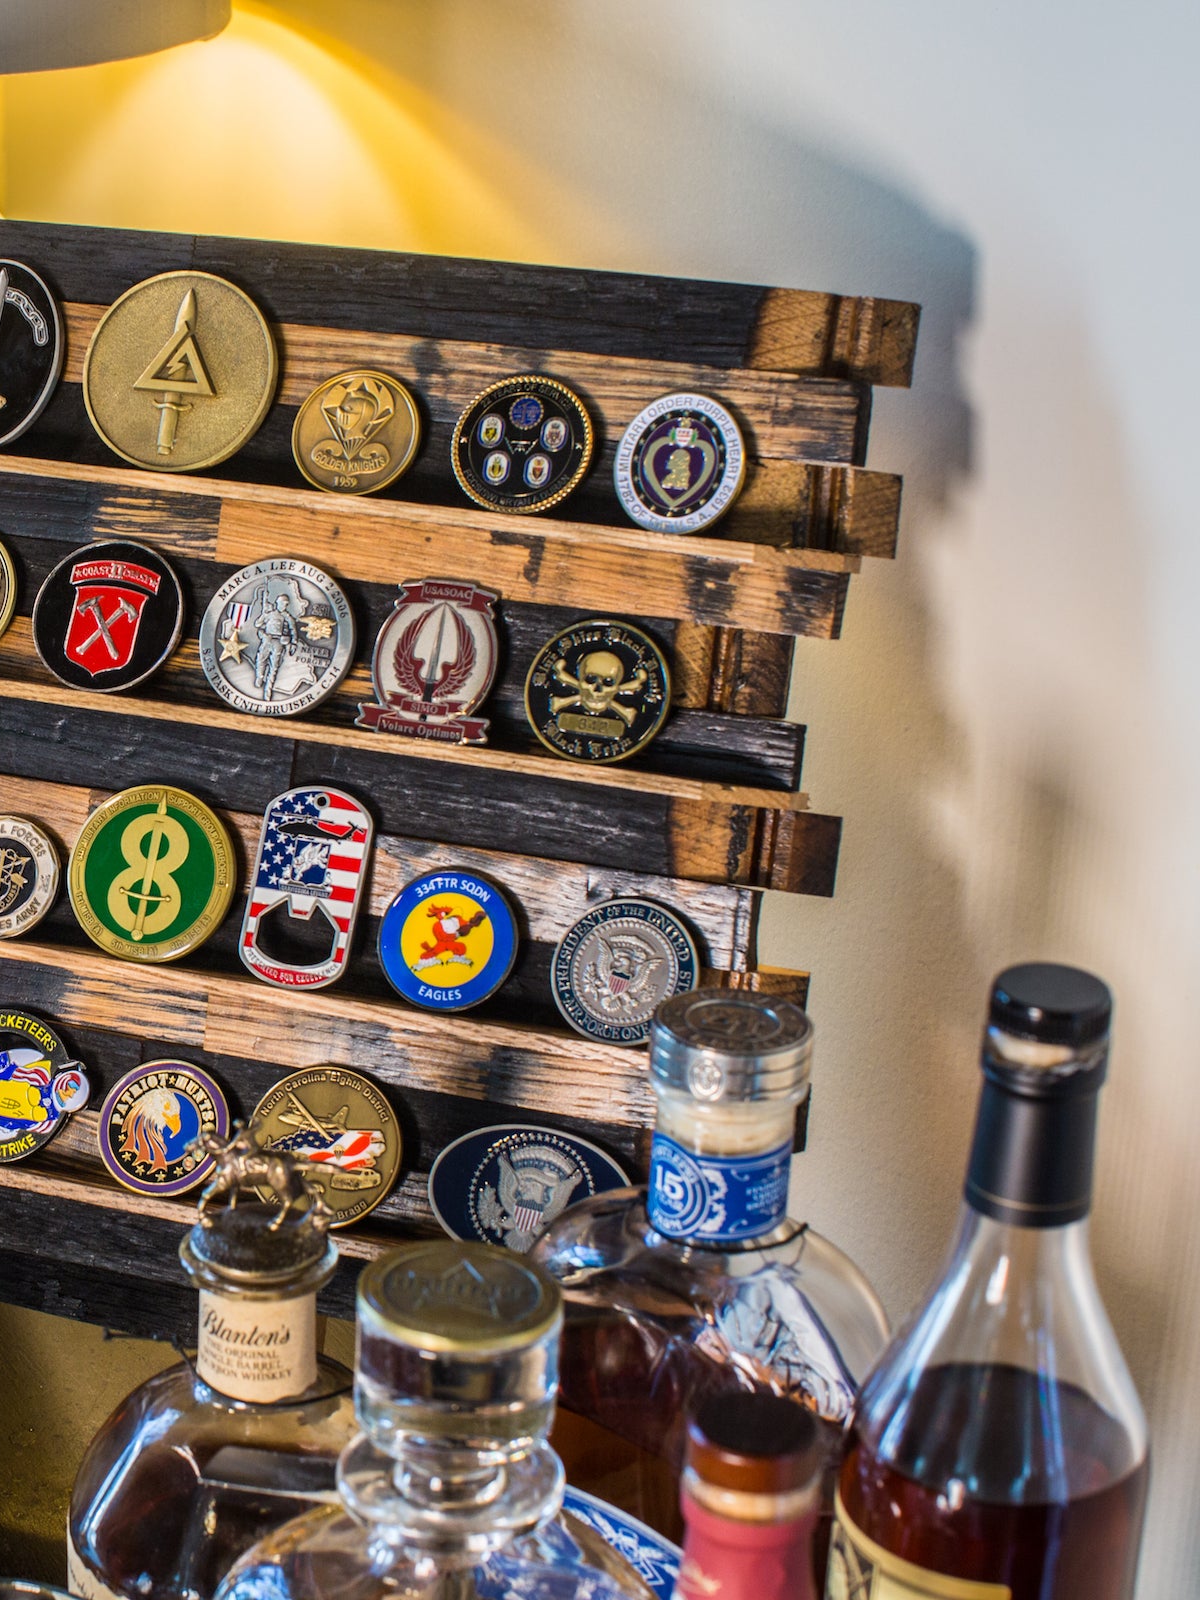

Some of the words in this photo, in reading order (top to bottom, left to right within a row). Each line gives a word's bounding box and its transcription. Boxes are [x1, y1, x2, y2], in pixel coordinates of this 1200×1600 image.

[492, 385, 522, 400] YEARS
[539, 384, 573, 411] SERVICE
[648, 397, 693, 418] ORDER
[696, 399, 735, 437] PURPLE
[619, 416, 648, 472] MILITARY
[315, 452, 346, 472] GOLDEN
[348, 457, 385, 472] KNIGHTS
[727, 439, 742, 482] HEART
[334, 476, 358, 488] 1959
[619, 476, 635, 503] 1782
[711, 485, 732, 510] 1932
[631, 505, 645, 520] OF
[648, 516, 670, 529] THE
[82, 566, 109, 576] COAST
[219, 571, 250, 601] MARC
[255, 566, 266, 576] A.
[271, 561, 296, 571] LEE
[299, 565, 325, 583] AUG
[424, 585, 473, 599] USASOAC
[295, 655, 330, 667] FORGET
[301, 646, 330, 656] NEVER
[212, 672, 232, 699] TASK
[233, 695, 263, 713] UNIT
[265, 693, 315, 715] BRUISER
[410, 703, 439, 714] SIMO
[381, 720, 414, 734] Volare
[418, 725, 461, 740] Optimos
[10, 826, 46, 857] FORCES
[81, 812, 107, 849] MILITARY
[108, 791, 159, 813] INFORMATION
[169, 796, 200, 819] SUPPORT
[201, 814, 220, 839] GROUP
[215, 839, 227, 887] (AIRBORNE)
[438, 878, 458, 889] FTR
[460, 879, 491, 903] SQDN
[16, 897, 41, 925] ARMY
[558, 909, 604, 992] PRESIDENT
[606, 906, 621, 917] OF
[622, 905, 644, 917] THE
[648, 909, 690, 962] UNITED
[418, 985, 462, 1001] EAGLES
[563, 997, 583, 1024] AIR
[582, 1017, 620, 1039] FORCE
[621, 1022, 650, 1039] ONE
[111, 1073, 169, 1125] PATRIOT
[174, 1074, 214, 1122] HUNTS
[260, 1092, 284, 1117] North
[284, 1073, 327, 1092] Carolina
[329, 1070, 362, 1091] Eighth
[362, 1088, 390, 1123] District
[656, 1165, 684, 1200] 15
[336, 1200, 368, 1221] Bragg
[203, 1304, 291, 1347] Blanton's
[225, 1346, 279, 1360] ORIGINAL
[236, 1354, 283, 1371] BARREL
[241, 1367, 293, 1382] WHISKEY
